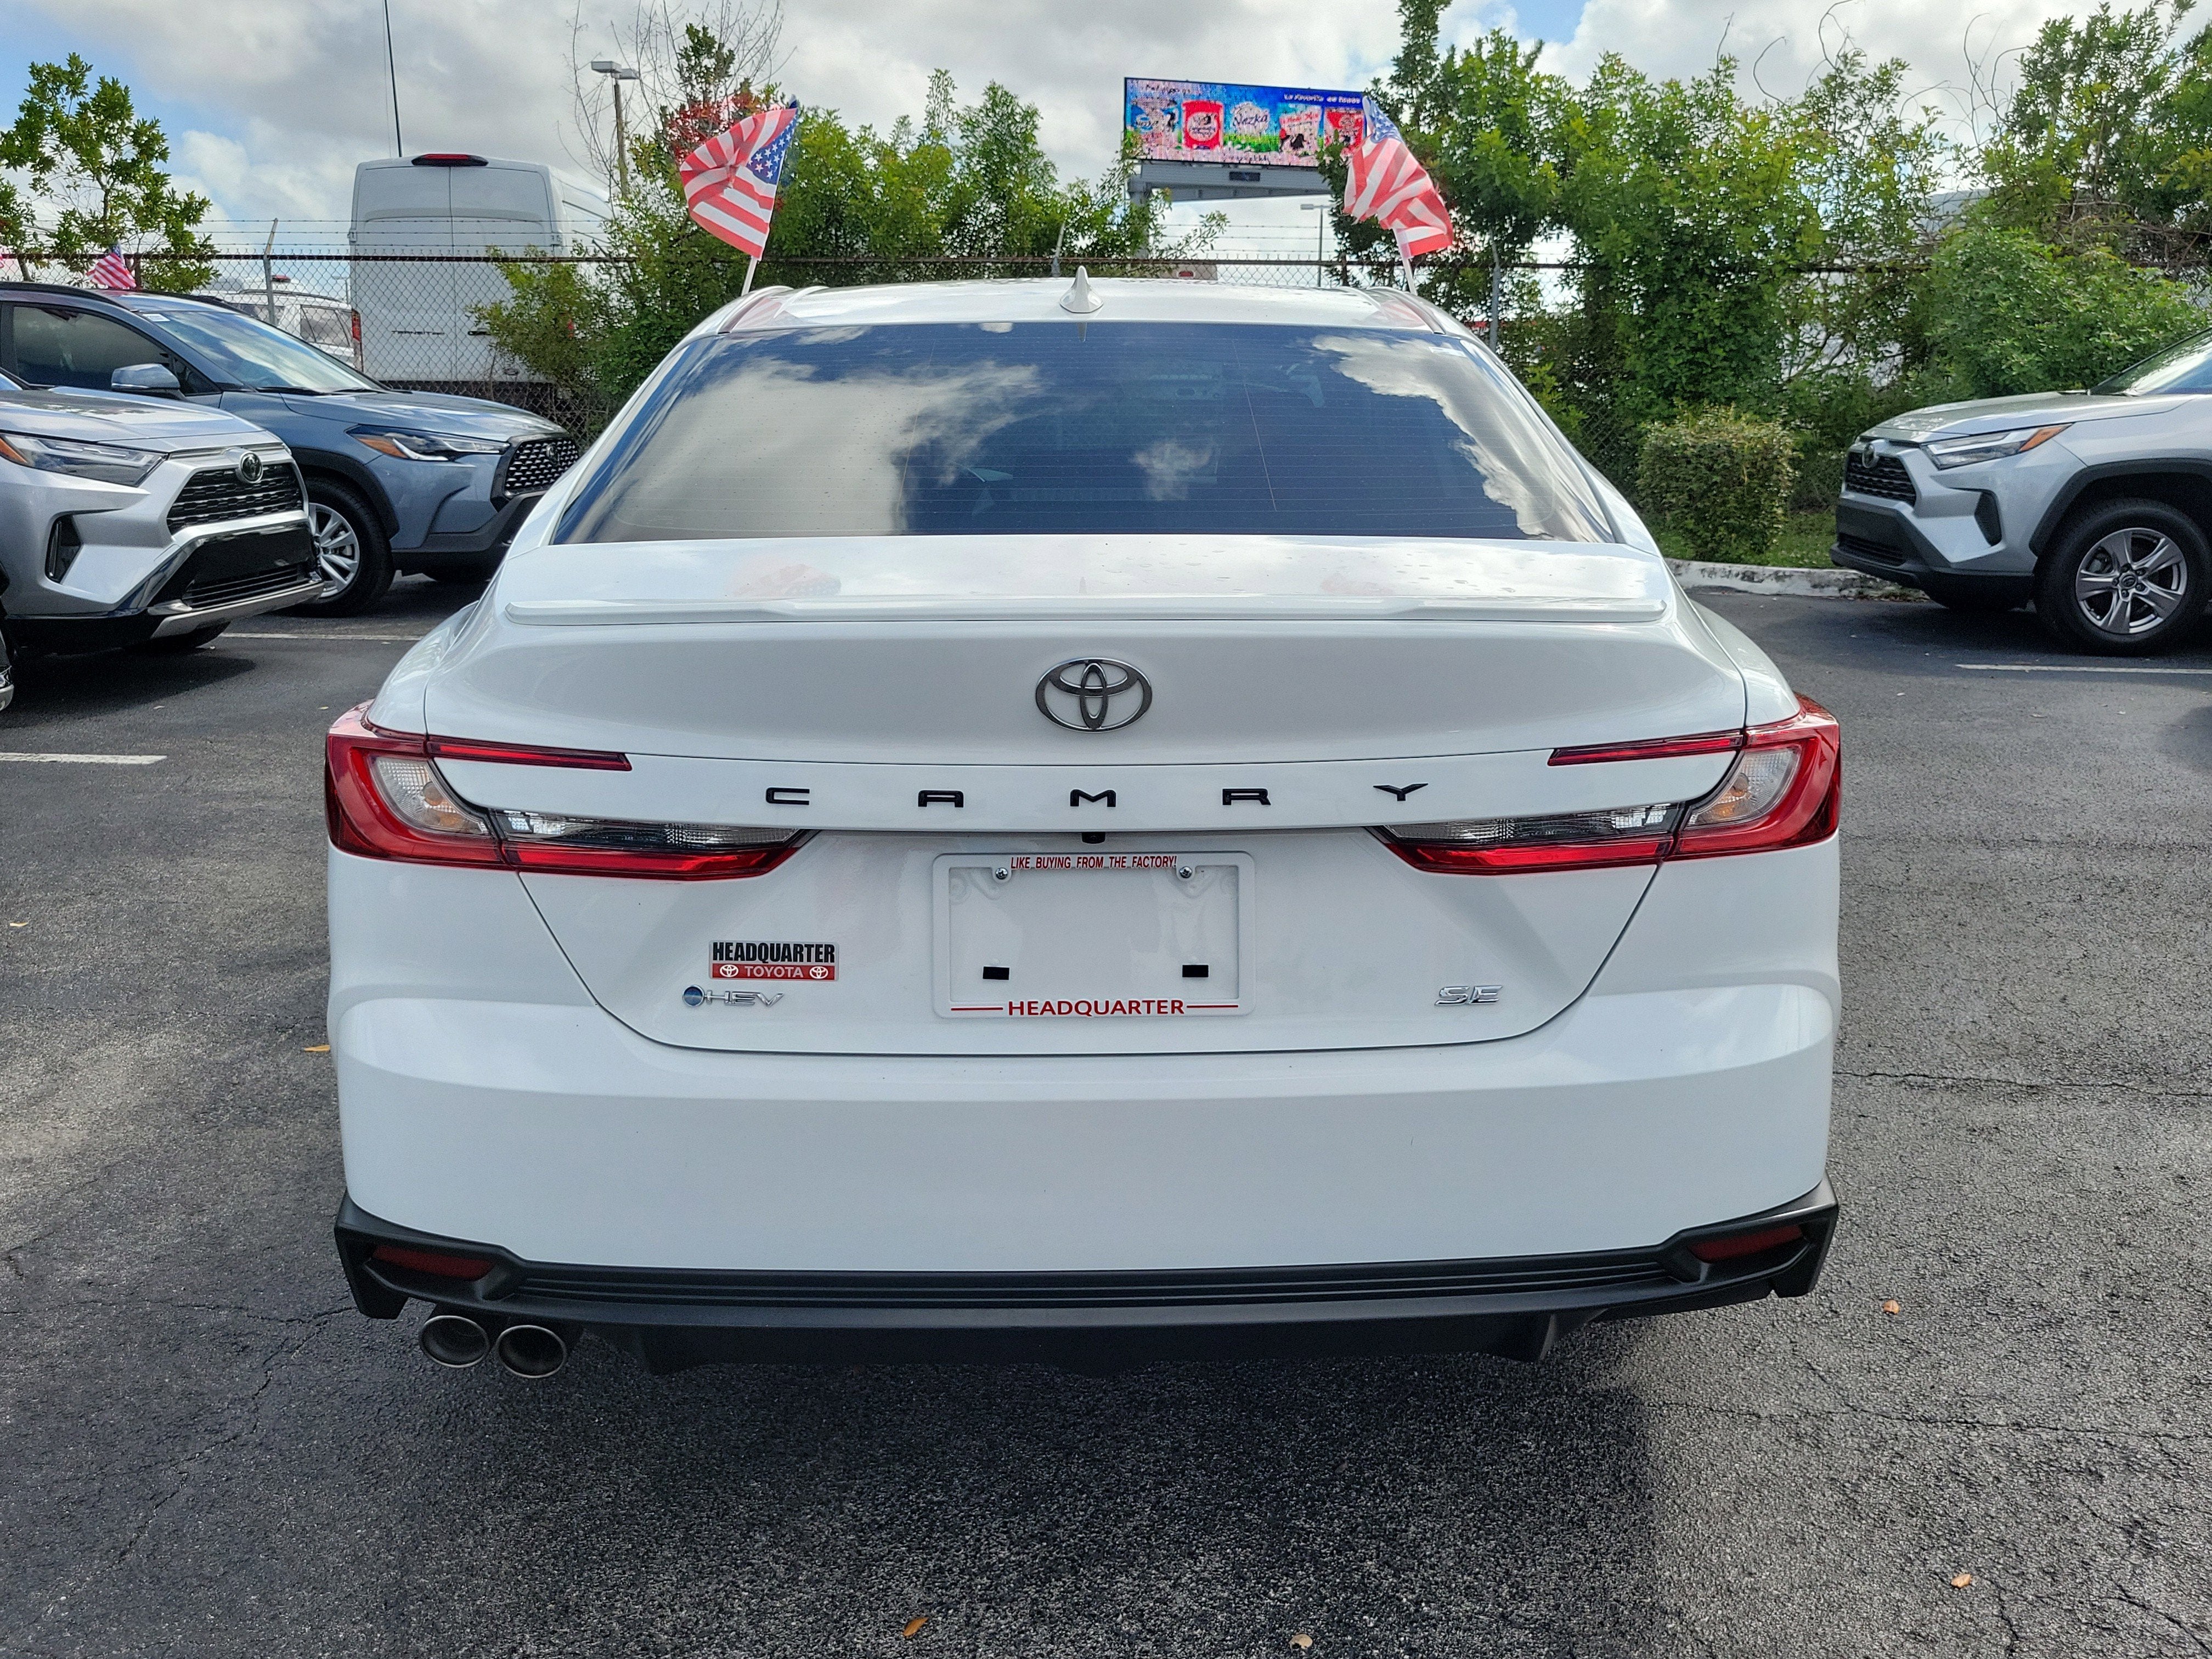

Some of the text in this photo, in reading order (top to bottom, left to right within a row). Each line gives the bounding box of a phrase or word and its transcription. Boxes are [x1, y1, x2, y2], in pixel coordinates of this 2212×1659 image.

[765, 783, 1429, 808] CAMRY
[1011, 855, 1177, 870] LIKE BUYING FROM THE FACTORY!
[713, 942, 835, 964] HEADQUARTER
[744, 965, 804, 978] TOYOTA
[706, 989, 785, 1008] HEV
[1434, 984, 1503, 1007] SE
[1008, 1000, 1185, 1017] HEADQUARTER
